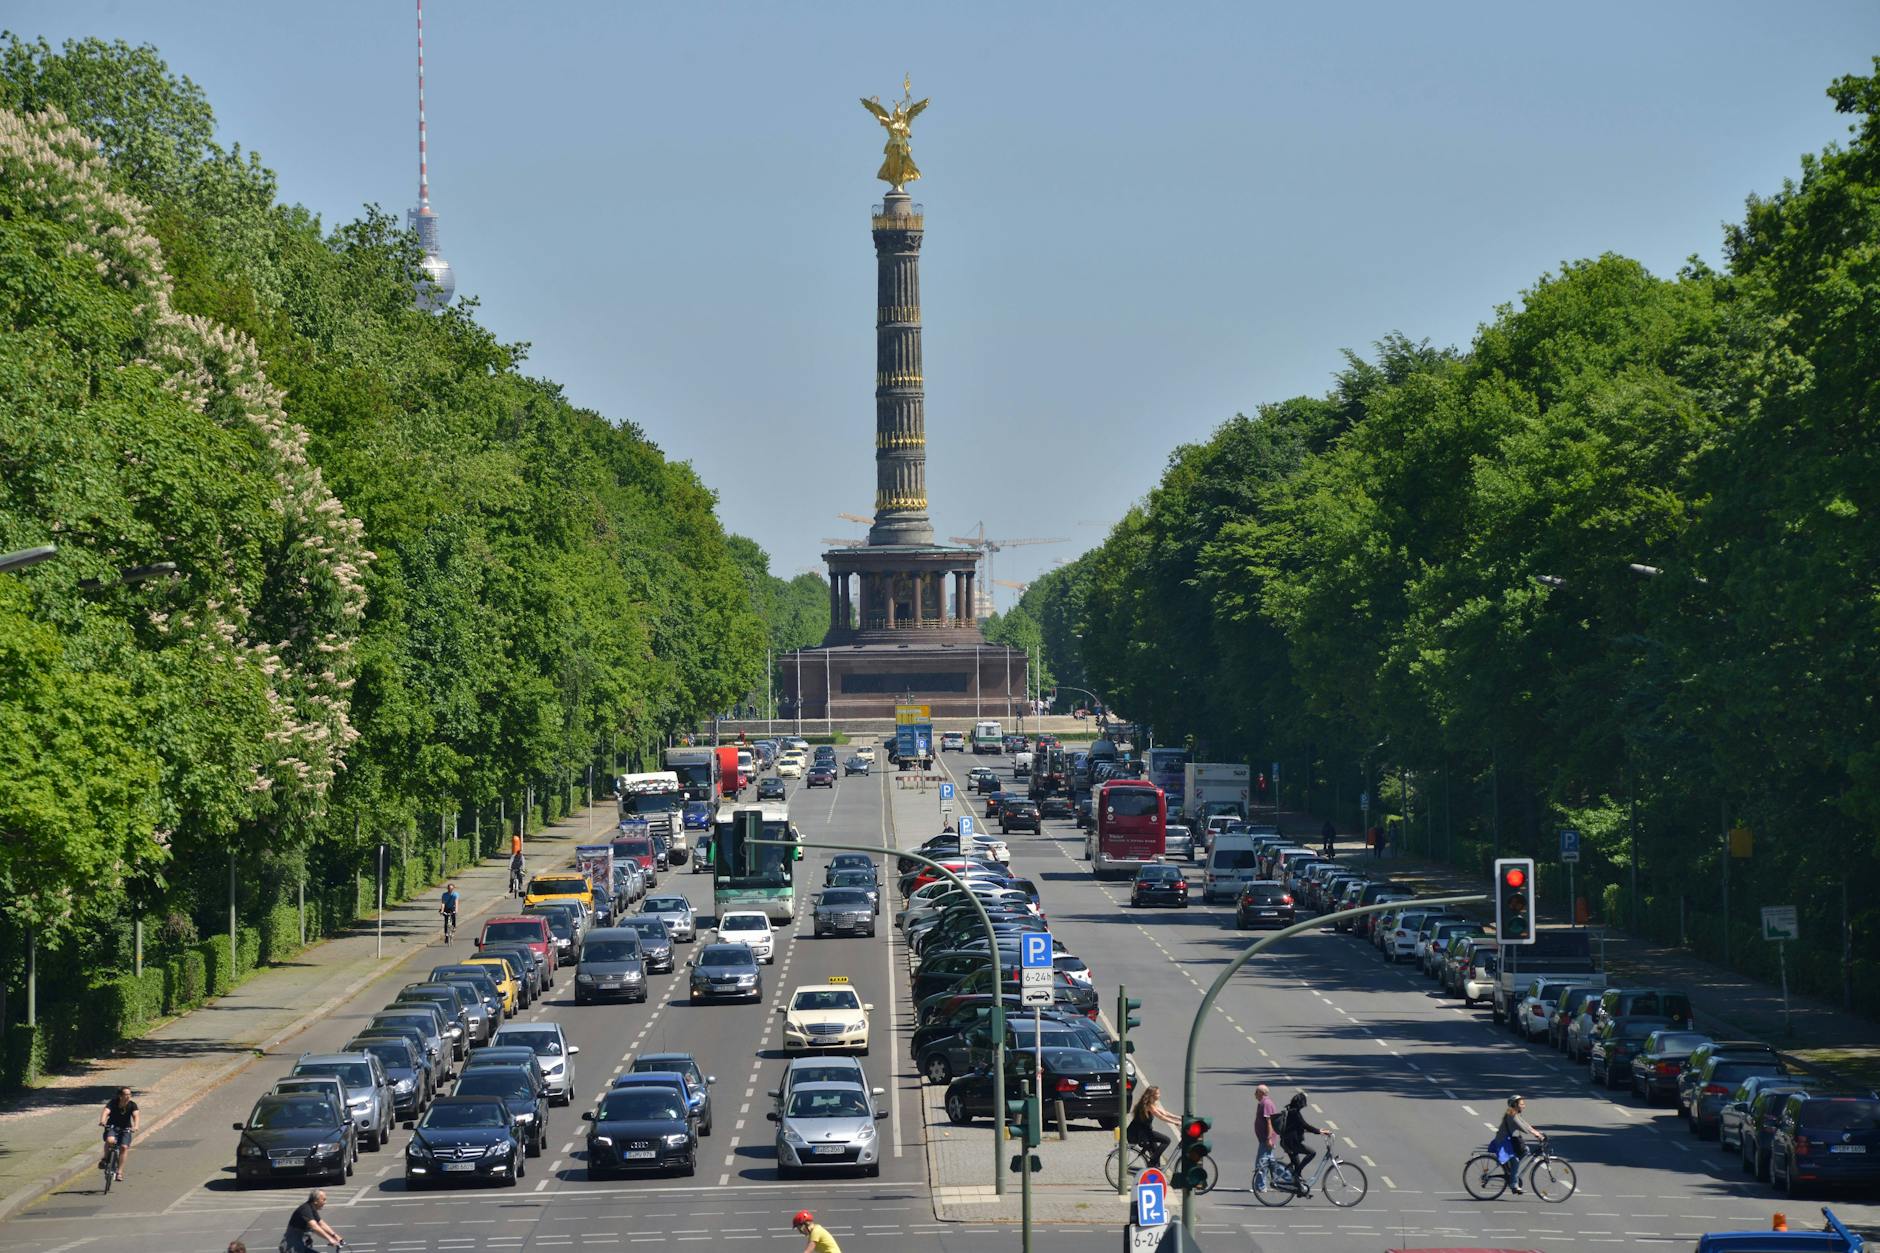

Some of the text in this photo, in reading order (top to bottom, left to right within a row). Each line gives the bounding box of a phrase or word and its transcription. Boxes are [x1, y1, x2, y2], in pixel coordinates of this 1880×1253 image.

[943, 785, 951, 797] P
[963, 819, 970, 833] P
[1565, 833, 1575, 849] P
[1029, 937, 1046, 963] P
[1025, 972, 1052, 982] 6-24h
[1142, 1190, 1156, 1220] P
